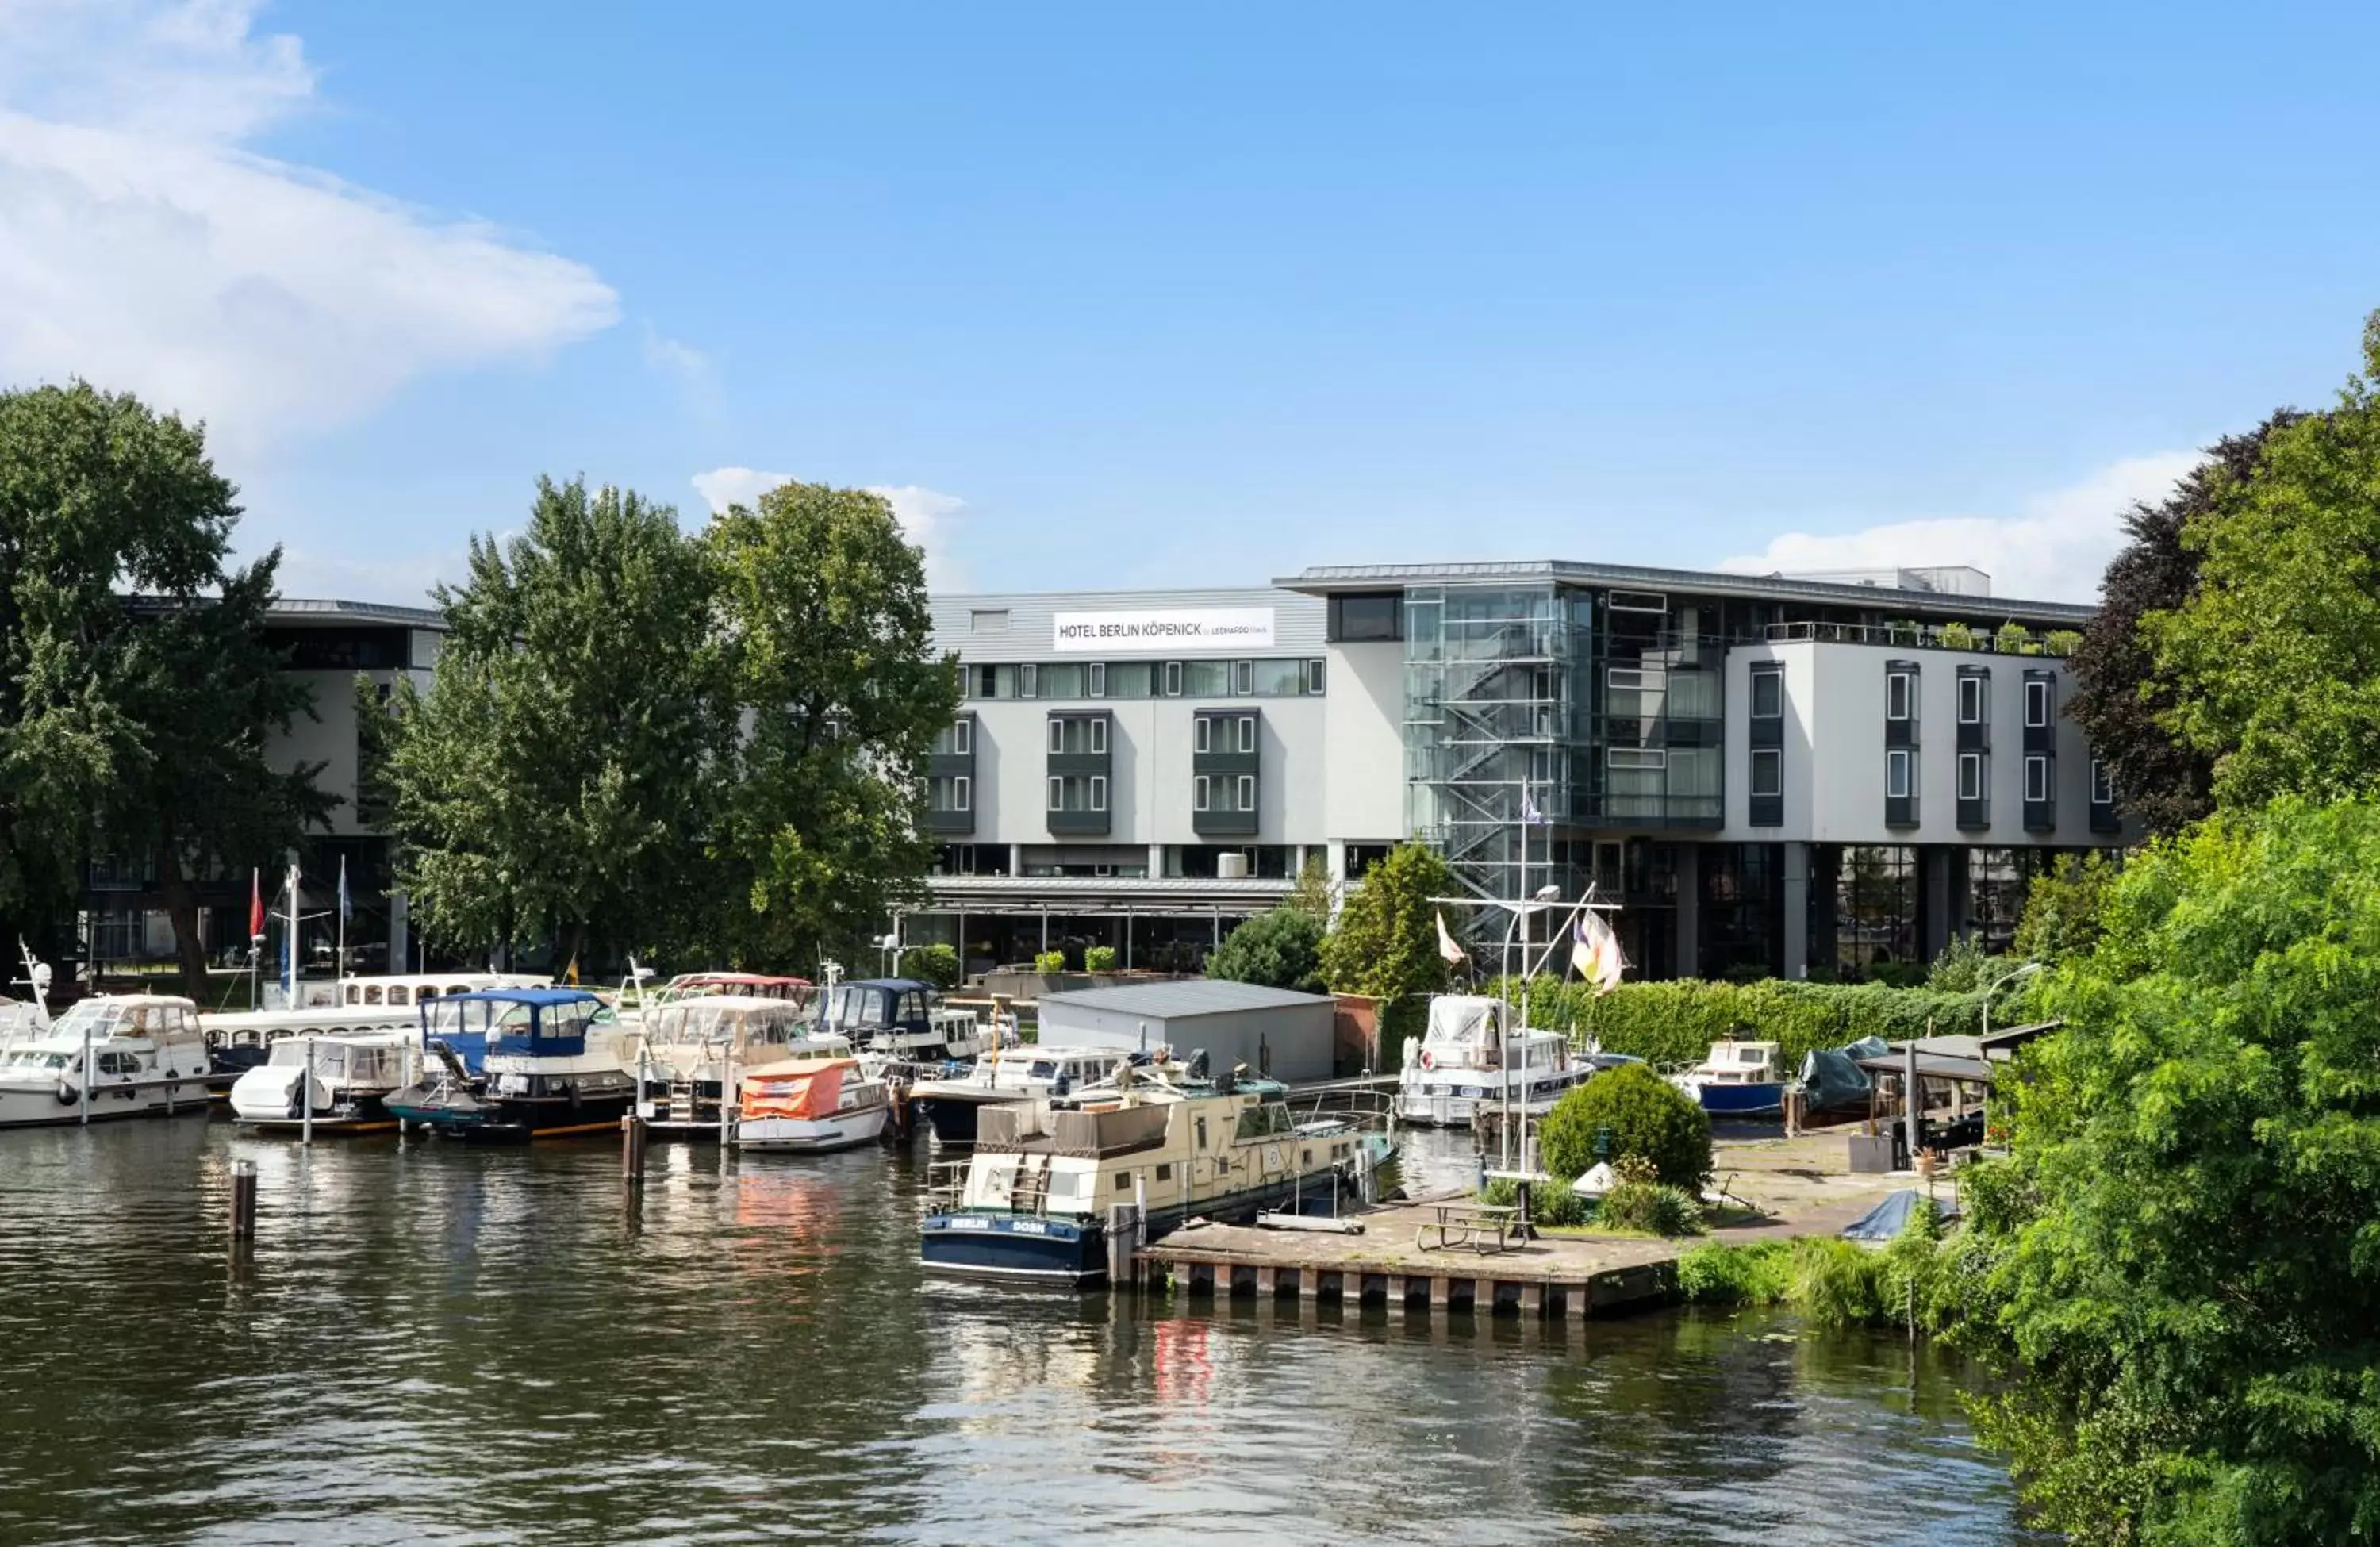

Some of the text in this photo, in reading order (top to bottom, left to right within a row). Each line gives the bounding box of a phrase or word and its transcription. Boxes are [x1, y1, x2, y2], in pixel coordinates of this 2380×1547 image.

[1059, 624, 1096, 638] HOTEL
[1099, 624, 1140, 637] BERLIN
[1142, 620, 1202, 636] KÖPENICK
